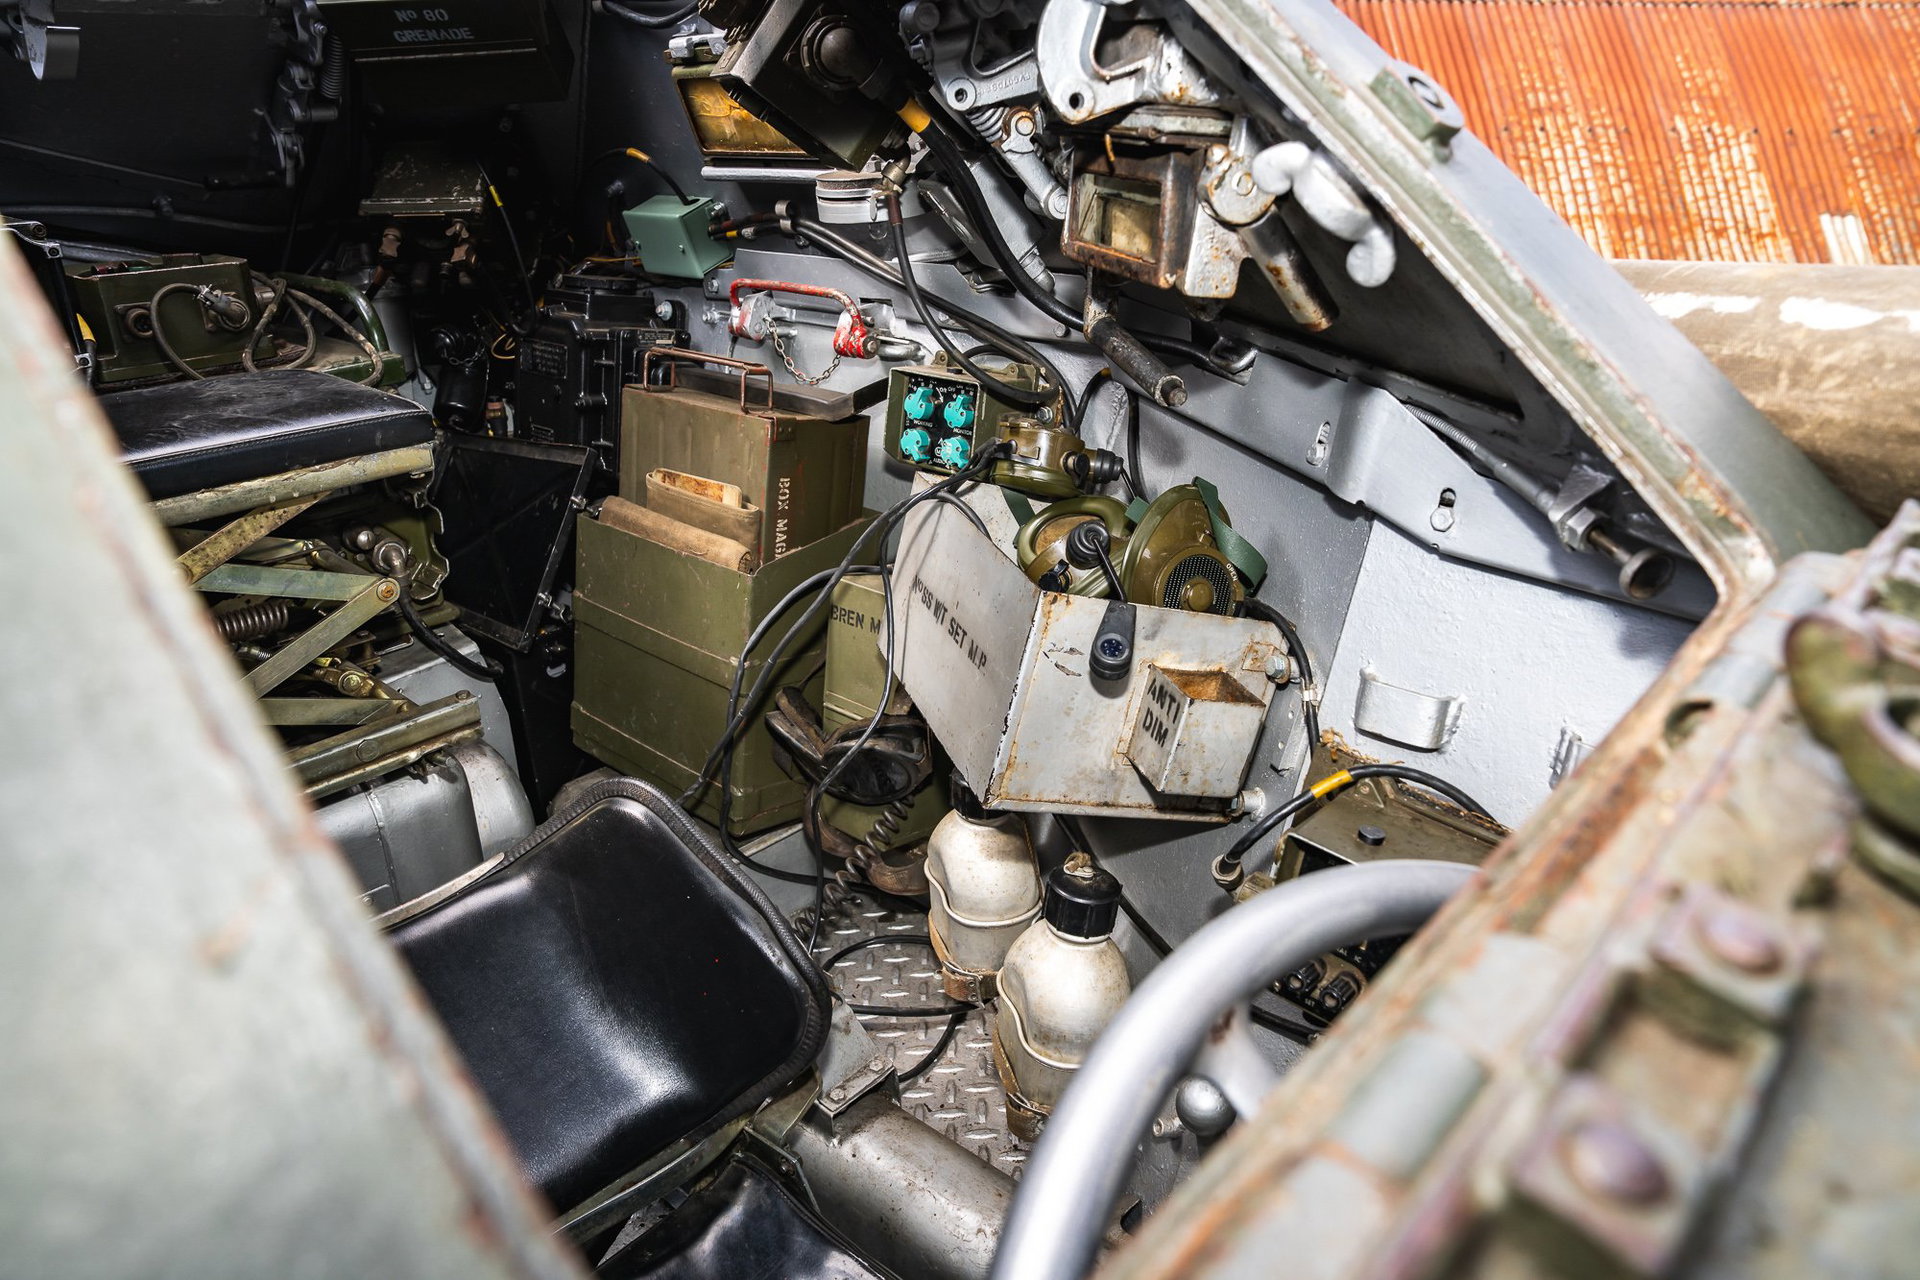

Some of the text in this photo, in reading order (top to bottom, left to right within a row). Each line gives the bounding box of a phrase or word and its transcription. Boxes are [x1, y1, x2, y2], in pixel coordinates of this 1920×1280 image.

[423, 9, 449, 22] 80
[393, 27, 475, 43] GRENADE
[952, 428, 973, 436] MONITOR
[778, 477, 791, 510] BOX
[1226, 563, 1238, 582] OPEN
[831, 604, 864, 630] BREN
[948, 616, 968, 649] SET
[1147, 678, 1180, 725] ANTI
[1142, 707, 1169, 748] DIM
